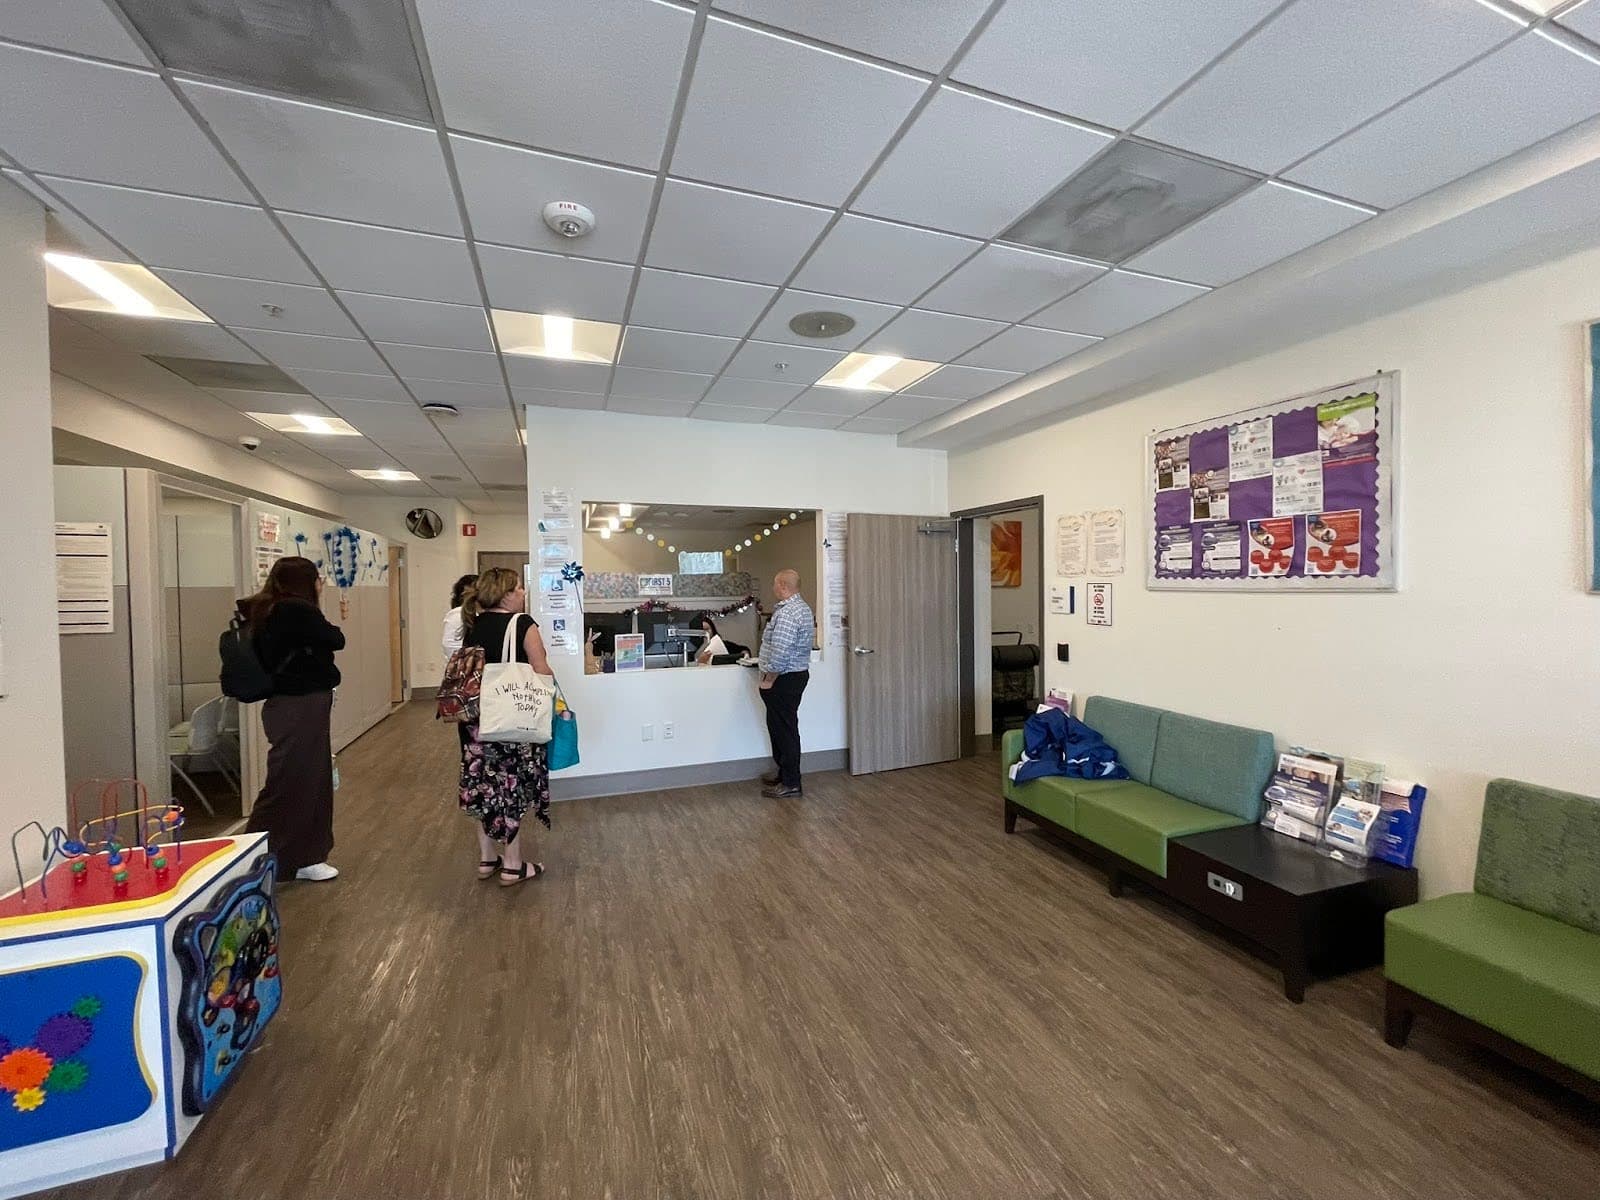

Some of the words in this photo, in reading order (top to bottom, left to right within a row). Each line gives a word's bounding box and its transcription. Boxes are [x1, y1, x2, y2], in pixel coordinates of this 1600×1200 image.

[666, 577, 671, 585] 5
[502, 682, 520, 693] WILL
[515, 703, 538, 718] TODAY
